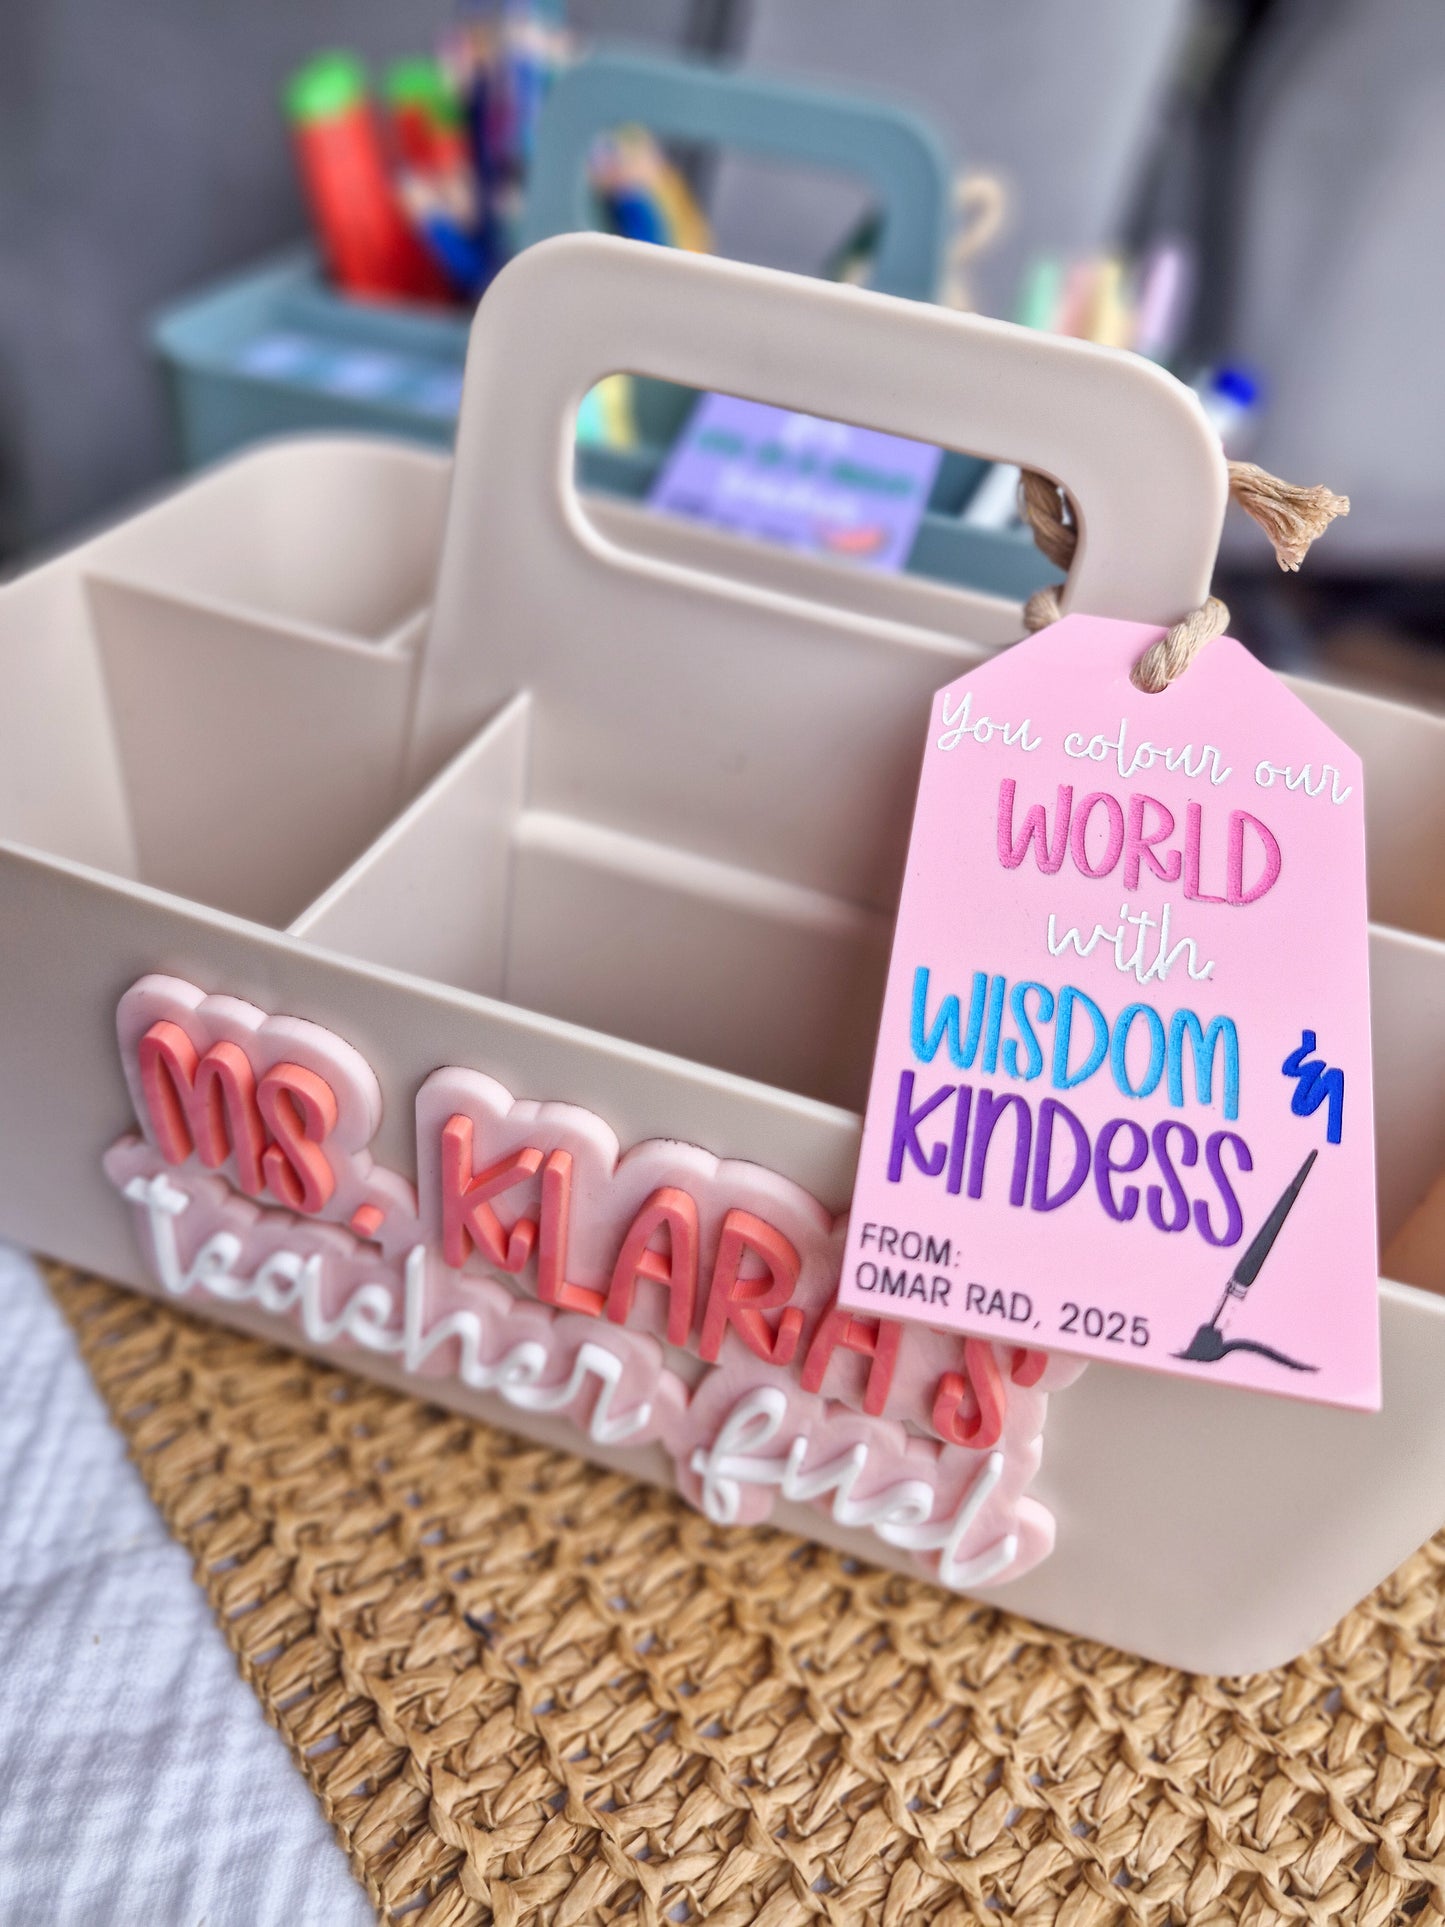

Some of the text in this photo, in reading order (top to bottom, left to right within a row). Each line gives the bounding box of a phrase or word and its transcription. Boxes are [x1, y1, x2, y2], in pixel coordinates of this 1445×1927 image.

[936, 690, 1354, 806] You colour our
[996, 777, 1283, 906] WORLD
[1045, 902, 1216, 985] with
[909, 965, 1240, 1121] WISDOM
[138, 1018, 387, 1238] MS.
[854, 1261, 1151, 1347] OMAR RAD, 2025
[858, 1221, 963, 1268] FROM:
[124, 1172, 1020, 1590] teacher fuel
